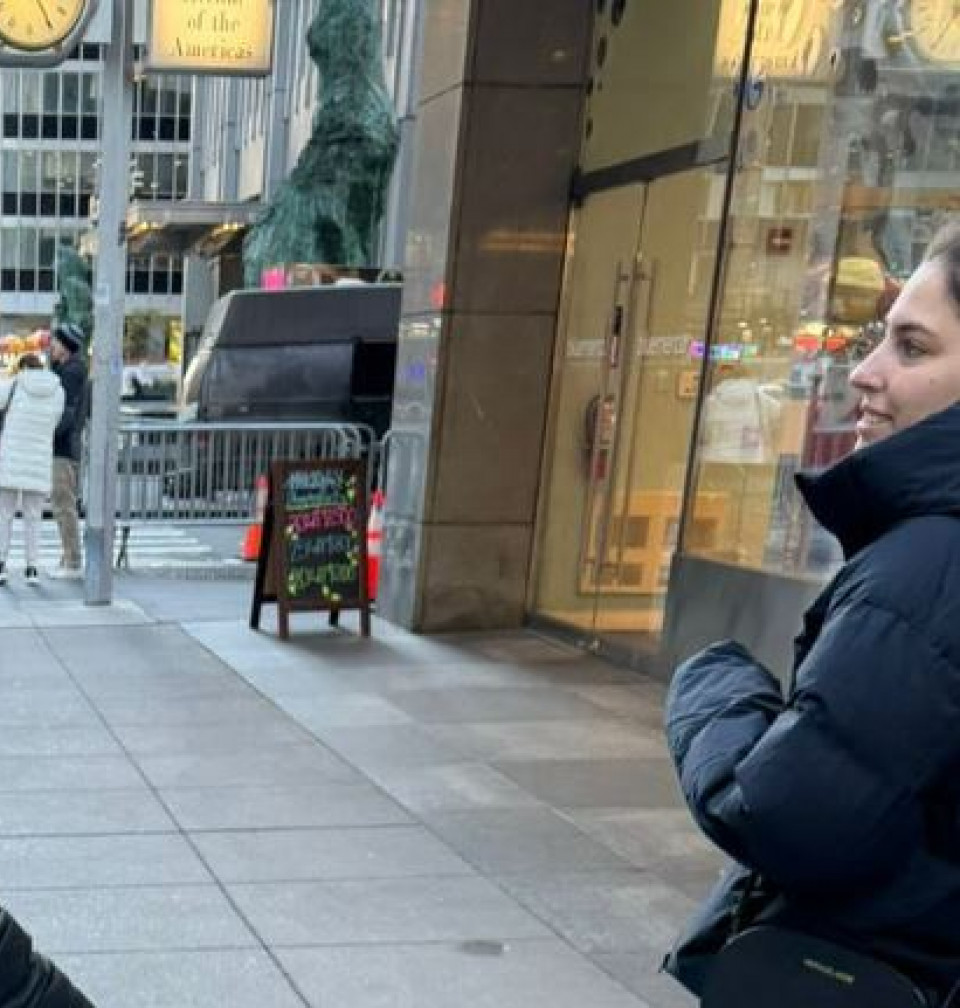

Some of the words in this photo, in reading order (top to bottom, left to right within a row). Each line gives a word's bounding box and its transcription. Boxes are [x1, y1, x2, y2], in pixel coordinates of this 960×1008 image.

[187, 9, 207, 30] of
[212, 11, 241, 33] the
[167, 37, 253, 58] Americas
